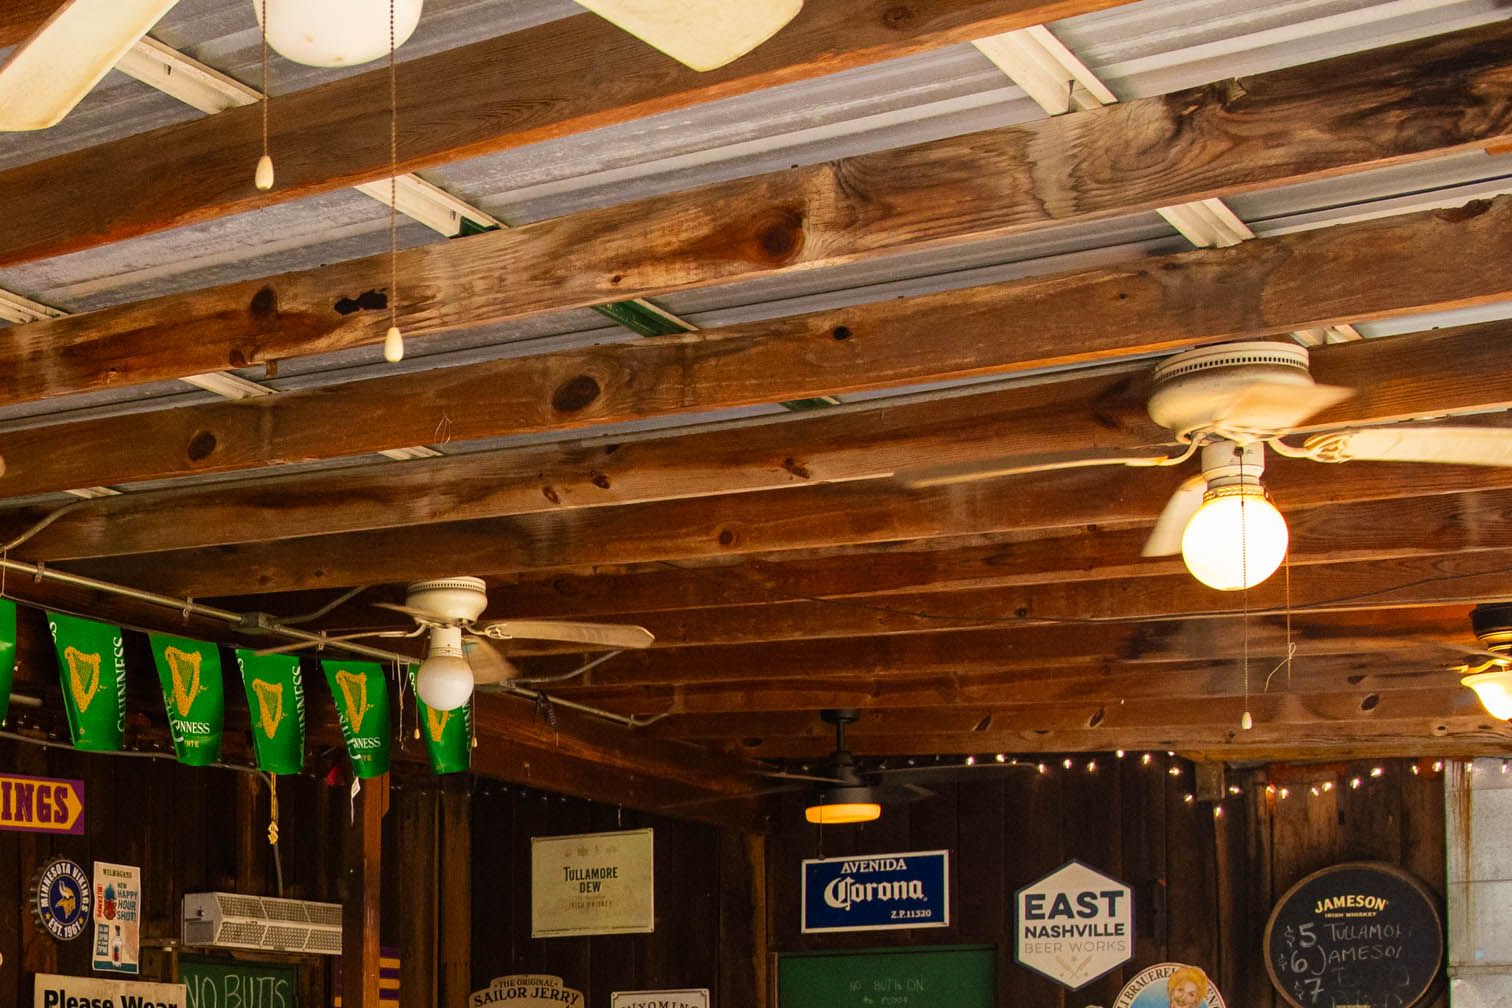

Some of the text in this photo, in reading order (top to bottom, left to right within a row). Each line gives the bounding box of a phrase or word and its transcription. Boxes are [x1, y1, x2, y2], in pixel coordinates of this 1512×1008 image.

[563, 866, 619, 882] TULLAMORE
[840, 858, 908, 875] AVENIDA
[40, 860, 71, 908] MINNESOTA
[71, 866, 89, 913] VIKINGS
[579, 881, 602, 893] DEW
[823, 876, 925, 911] Corona
[117, 890, 138, 900] HAPPY
[117, 899, 136, 911] HOUR
[1025, 890, 1124, 920] EAST
[1315, 894, 1385, 914] JAMESON
[48, 918, 82, 938] EST. 1961
[1025, 923, 1125, 939] NASHVILLE
[1025, 940, 1126, 954] BEER WORKS
[499, 980, 554, 989] THE ORIGINAL
[474, 986, 580, 1008] SAILOR JERRY
